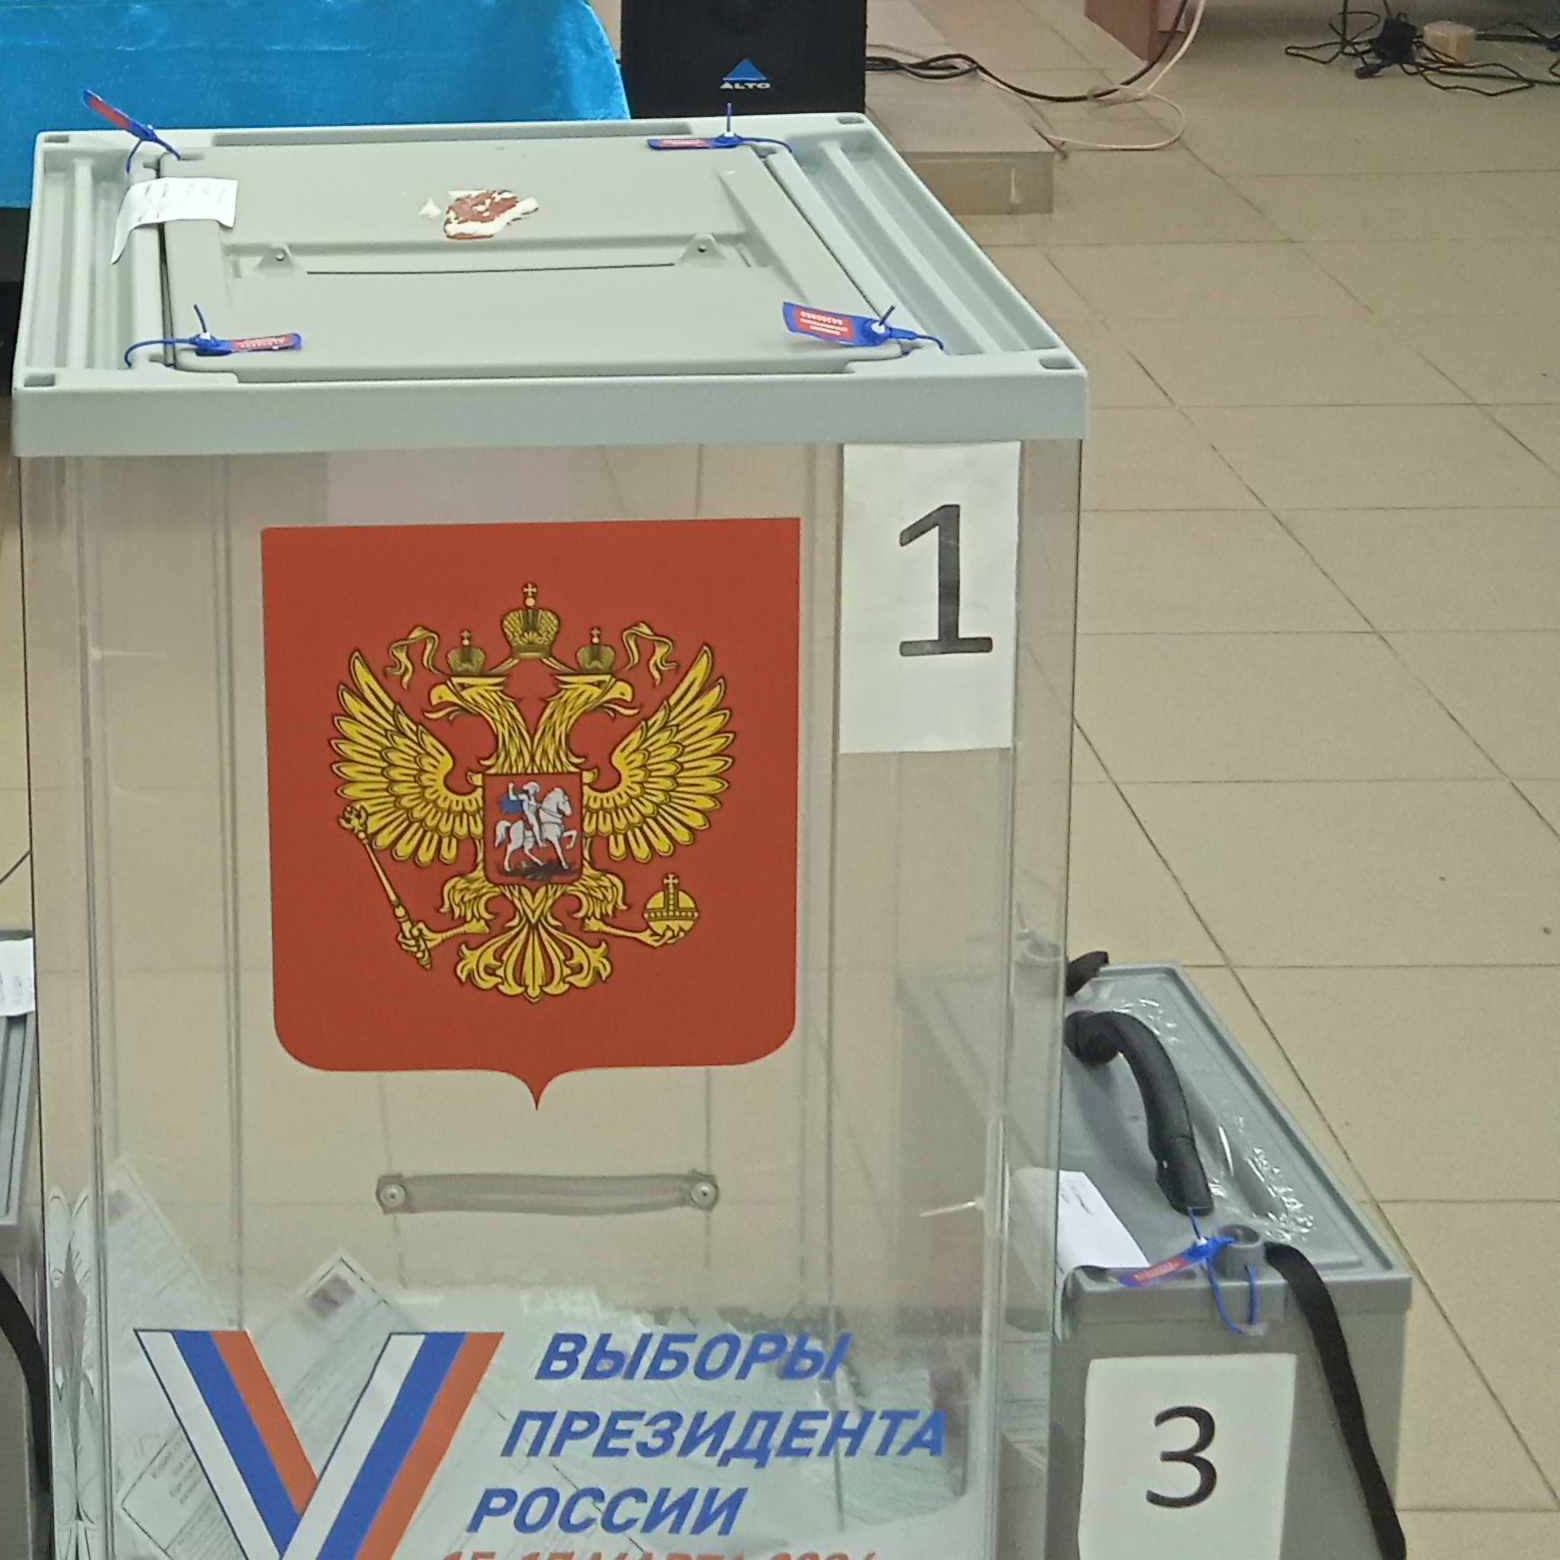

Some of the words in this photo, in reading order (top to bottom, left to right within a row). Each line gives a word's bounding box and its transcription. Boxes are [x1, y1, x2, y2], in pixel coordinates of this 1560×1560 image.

[720, 82, 771, 90] ALTO
[900, 504, 993, 657] 1
[534, 1332, 852, 1381] ВЫБОРЫ
[500, 1409, 945, 1468] ПРЕЗИДЕНТА
[1146, 1405, 1217, 1509] 3
[466, 1487, 748, 1536] РОССИИ
